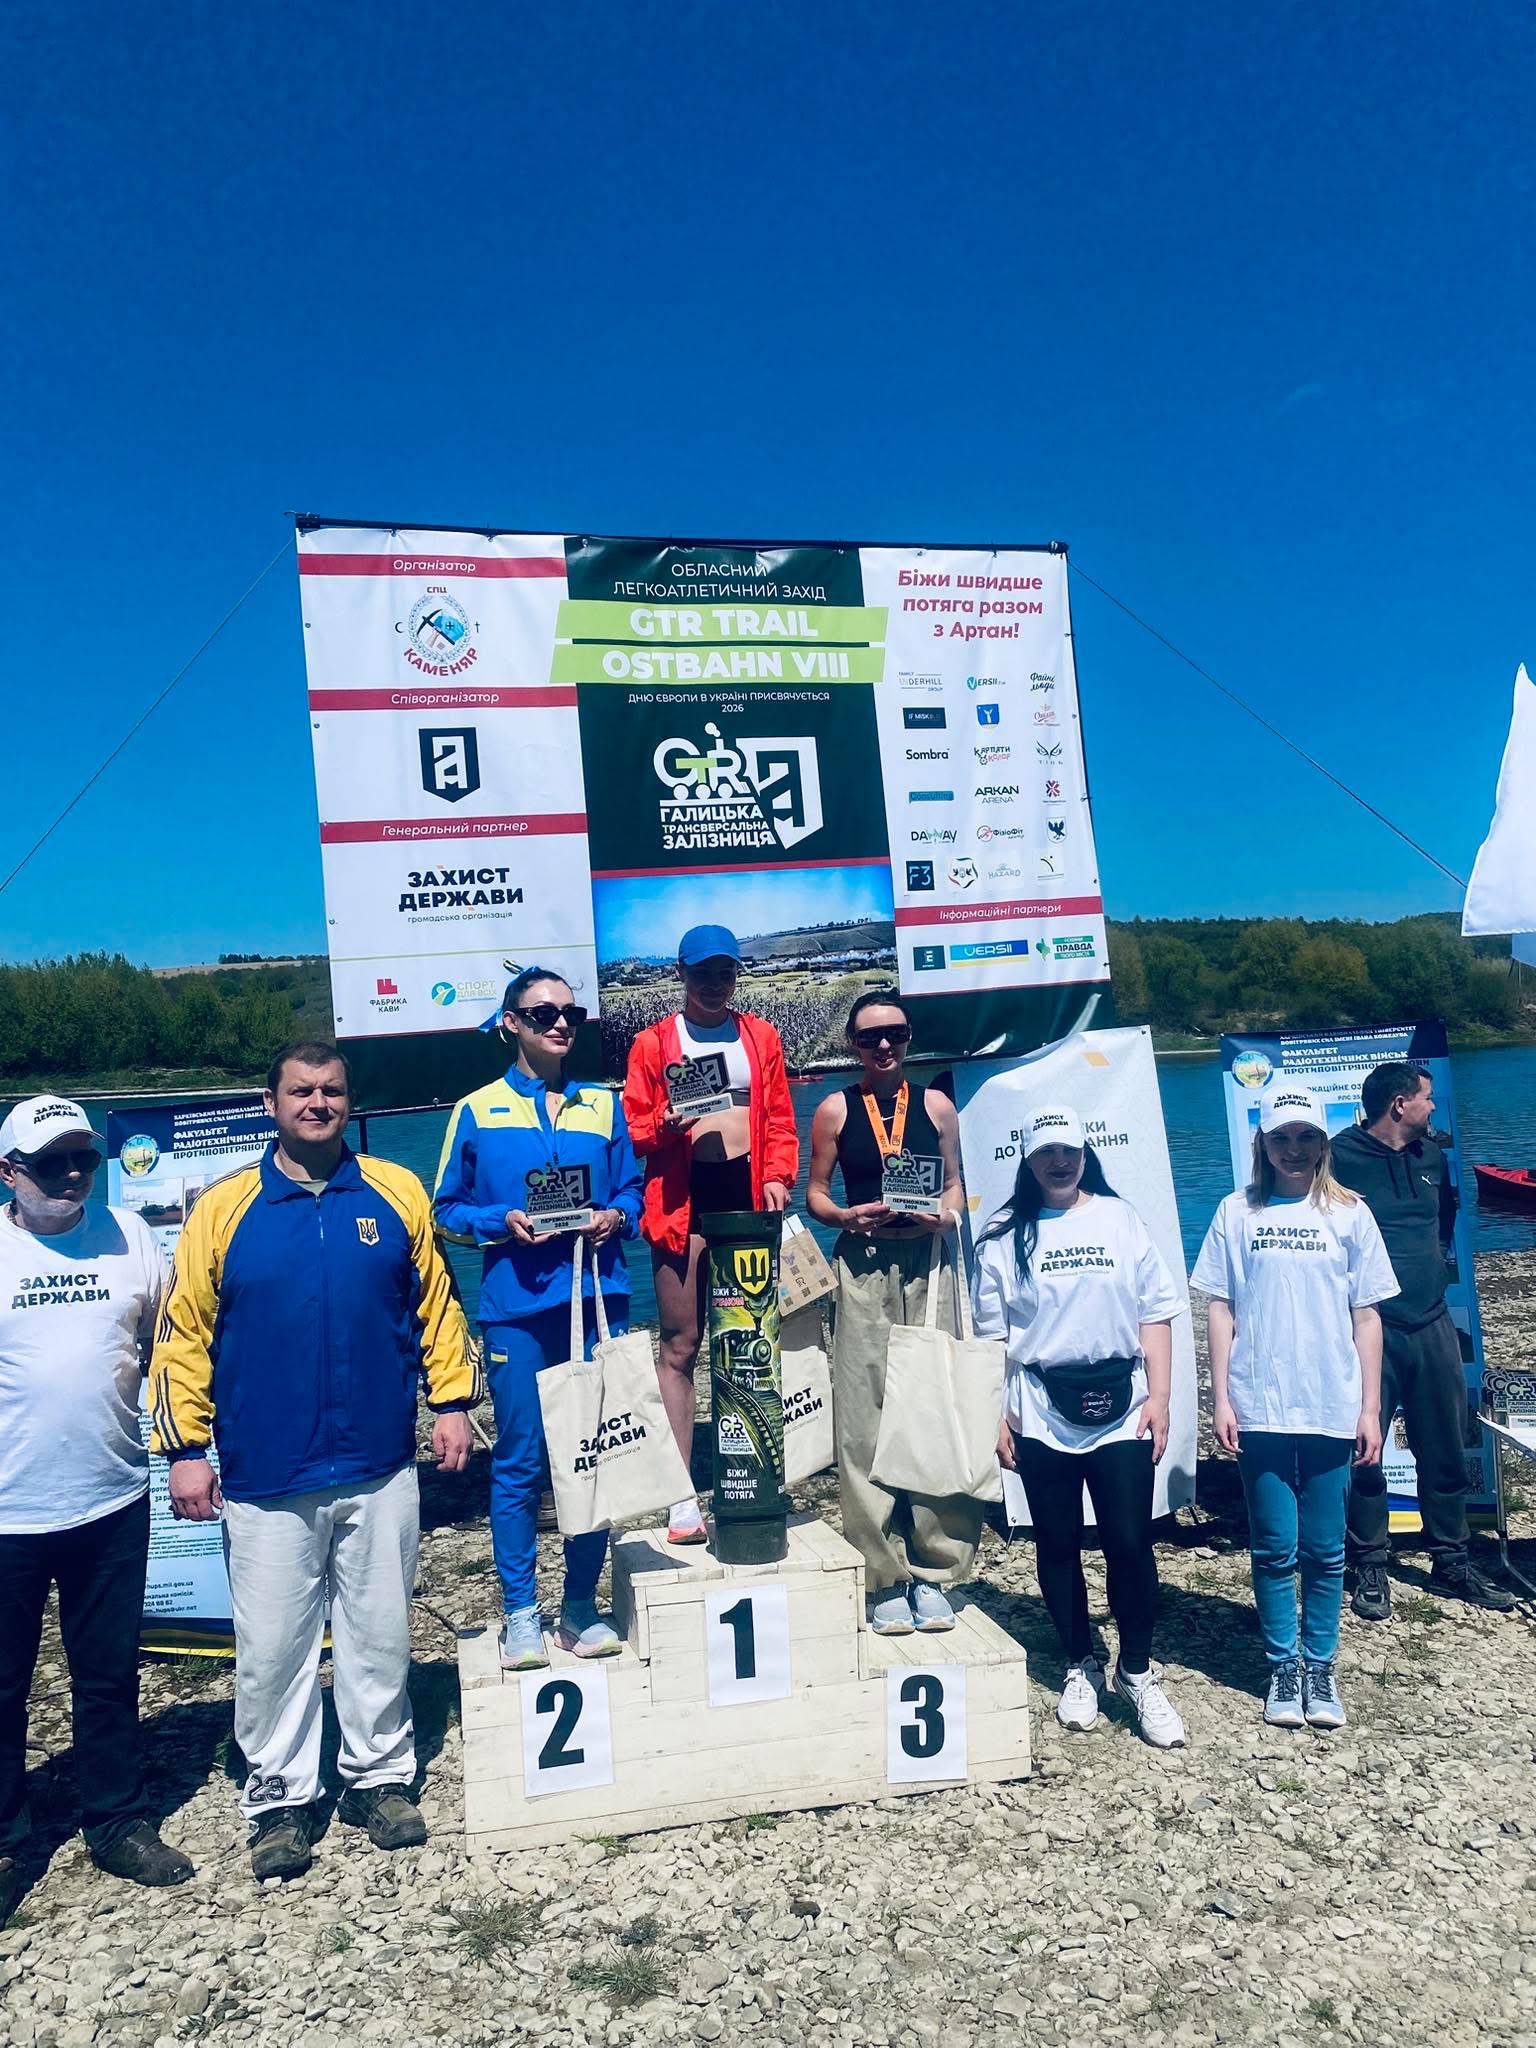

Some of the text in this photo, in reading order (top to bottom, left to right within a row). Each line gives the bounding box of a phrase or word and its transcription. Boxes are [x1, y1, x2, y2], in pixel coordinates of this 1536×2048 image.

[393, 559, 476, 573] Організатор
[671, 562, 767, 577] ОБЛАСНИЙ
[898, 569, 1043, 591] Біжи швидше
[613, 581, 827, 601] ЛЕГКОАТЛЕТИЧНИЙ ЗАХІД
[902, 598, 1043, 617] потяга разом
[630, 608, 818, 637] GTR TRAIL
[933, 622, 1020, 641] з Артан!
[403, 647, 477, 676] КАМЕНЯР
[602, 650, 849, 679] OSTBAHN VIII
[391, 692, 499, 705] Співорганізатор
[628, 691, 830, 704] ДНЮ ЄВРОПИ В УКРАЇНІ ПРИСВЯЧУЄТЬСЯ
[721, 704, 744, 713] 2026
[905, 748, 949, 760] Sombra
[975, 785, 1019, 797] ARKAN
[660, 804, 763, 823] ГАЛИЦЬКА
[382, 821, 528, 837] Генеральний партнер
[662, 821, 769, 834] ТРАНСВЕРСАЛЬНА
[663, 830, 776, 850] ЗАЛІЗНИЦЯ
[408, 867, 510, 888] ЗАХИСТ
[398, 887, 523, 912] ДЕРЖАВИ
[407, 911, 513, 924] громадська організація
[939, 904, 1062, 921] Інформаційні партнери
[1056, 943, 1093, 952] ПРАВДА
[457, 981, 496, 990] СПОРТ
[369, 998, 407, 1006] ФАБРИКА
[378, 1005, 400, 1013] КАВИ
[1281, 1047, 1338, 1057] ФАКУЛЬТЕТ
[1283, 1051, 1408, 1066] РАДІОТЕХНІЧНИХ ВІЙСЬК
[1273, 1099, 1312, 1109] ДЕРЖАВИ
[1276, 1093, 1308, 1102] ЗАХИСТ
[35, 1104, 72, 1115] ЗАХИСТ
[33, 1111, 79, 1124] ДЕРЖАВИ
[1034, 1114, 1064, 1124] ЗАХИСТ
[173, 1126, 229, 1139] ФАКУЛЬТЕТ
[1032, 1120, 1069, 1132] ДЕРЖАВИ
[173, 1130, 280, 1149] РАДІОТЕХНІЧНИХ ВІЙС
[994, 1147, 1016, 1161] ДО
[1256, 1226, 1319, 1239] ЗАХИСТ
[1250, 1238, 1327, 1252] ДЕРЖАВИ
[1044, 1246, 1106, 1259] ЗАХИСТ
[1040, 1257, 1115, 1273] ДЕРЖАВИ
[19, 1273, 99, 1290] ЗАХИСТ
[11, 1289, 110, 1309] ДЕРЖАВИ
[782, 1387, 812, 1411] ИСТ
[782, 1397, 823, 1426] ЖАВИ
[727, 1468, 748, 1477] БІЖИ
[721, 1480, 758, 1490] ШВИДШЕ
[724, 1491, 755, 1499] ПОТЯГА
[719, 1598, 757, 1680] 1
[900, 1674, 945, 1759] 3
[535, 1680, 585, 1770] 2
